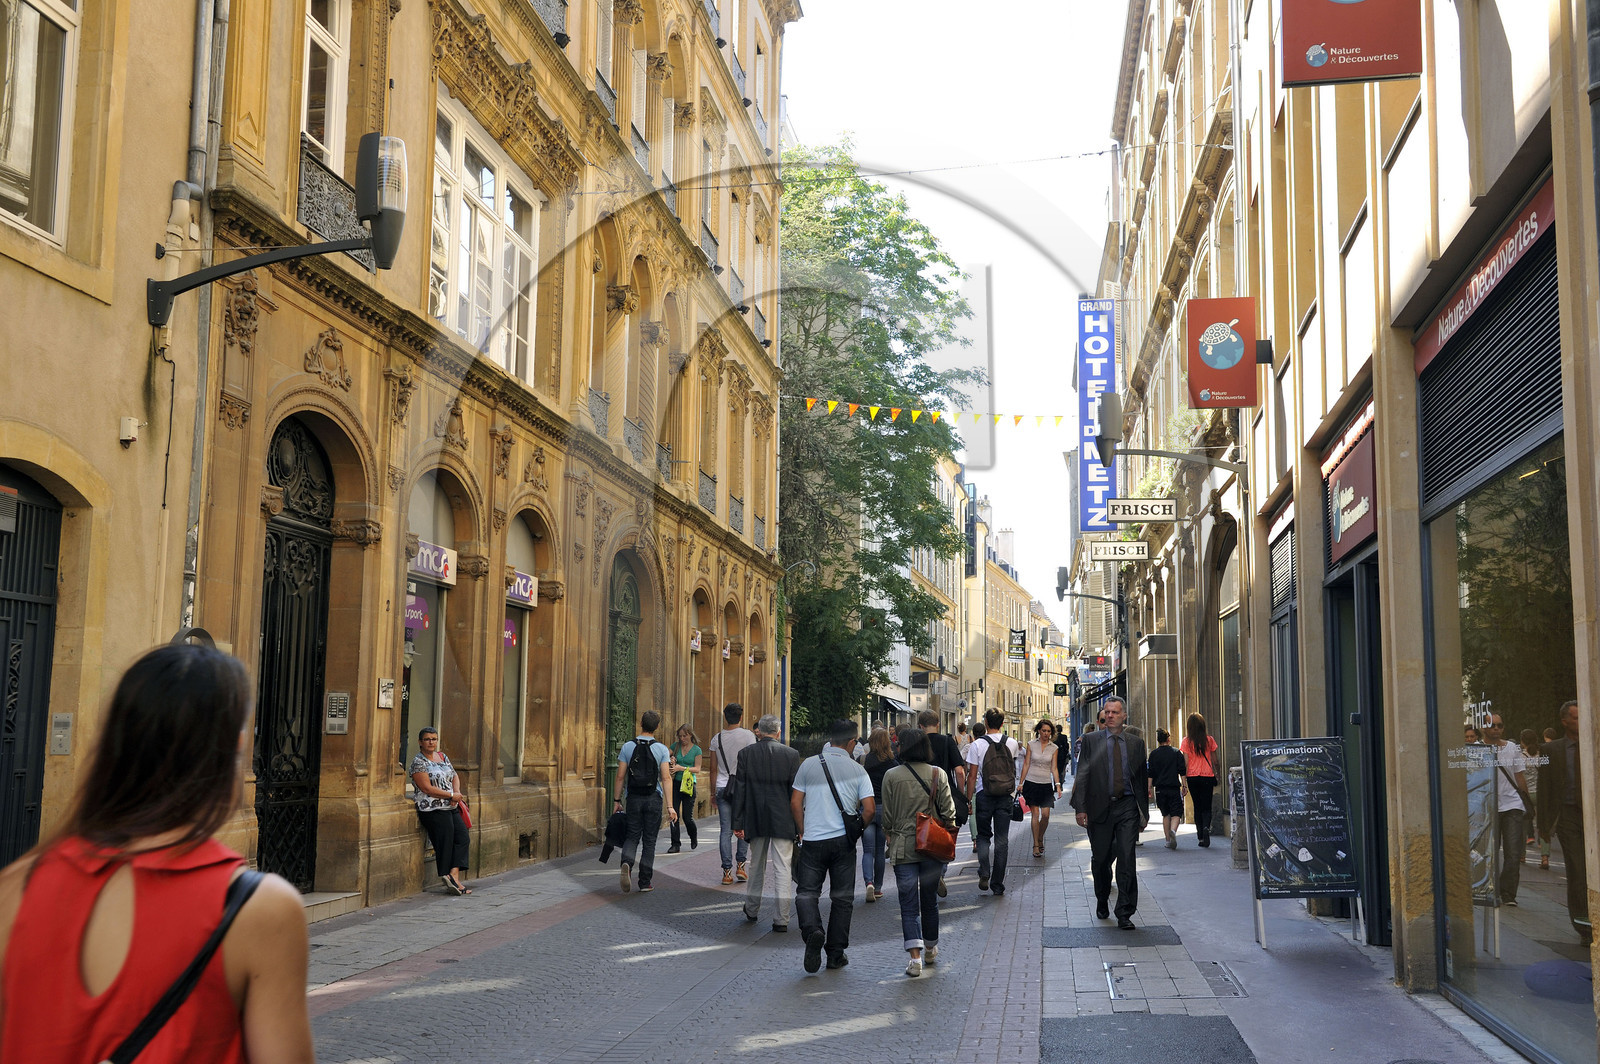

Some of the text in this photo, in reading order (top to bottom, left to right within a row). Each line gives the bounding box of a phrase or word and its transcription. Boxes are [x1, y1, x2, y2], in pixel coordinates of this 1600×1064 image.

[1330, 47, 1361, 55] Nature
[1338, 53, 1399, 64] Découvertes
[1437, 211, 1539, 346] Nature & Découvertes
[1080, 301, 1113, 312] GRAND
[1110, 504, 1174, 516] FRISCH
[1093, 545, 1146, 556] FRISCH
[1469, 691, 1493, 730] THÉS
[1255, 745, 1323, 756] Les animations
